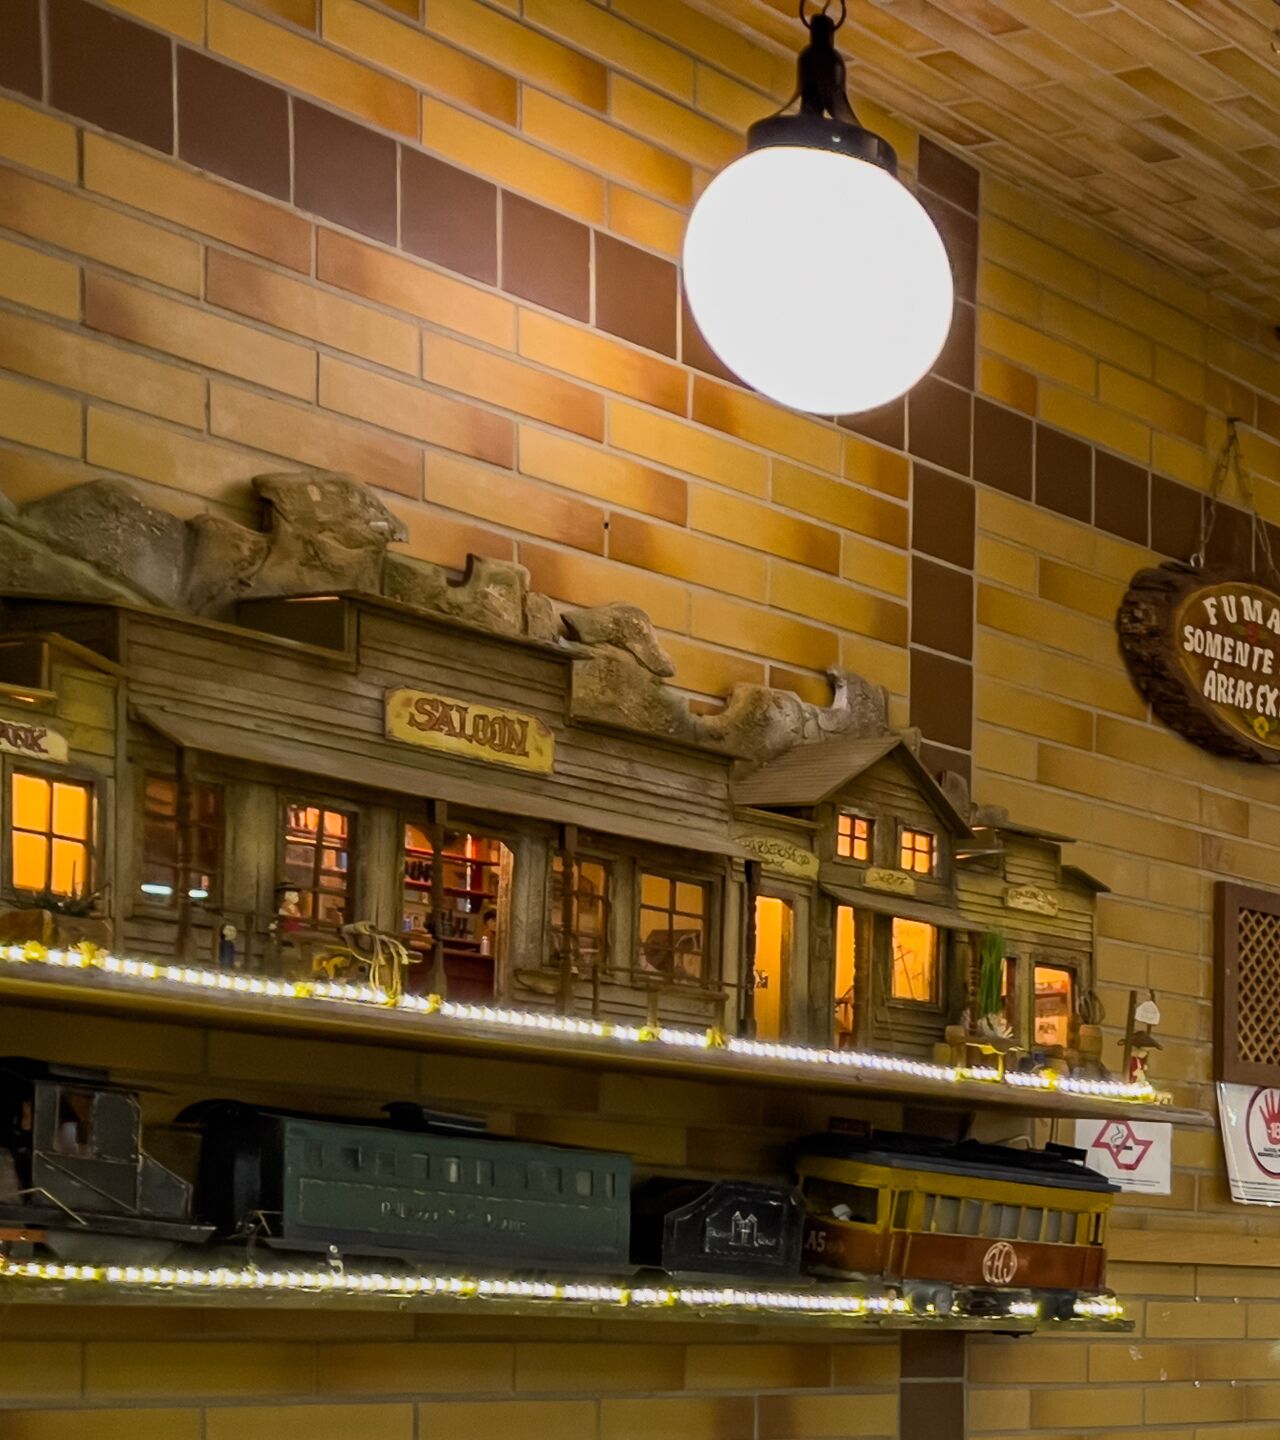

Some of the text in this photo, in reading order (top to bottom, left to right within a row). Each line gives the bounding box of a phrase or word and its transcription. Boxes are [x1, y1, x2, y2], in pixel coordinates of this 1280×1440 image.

[1183, 625, 1273, 674] SOMENTE
[1203, 660, 1253, 710] ÁREAS
[407, 698, 530, 758] SALOON
